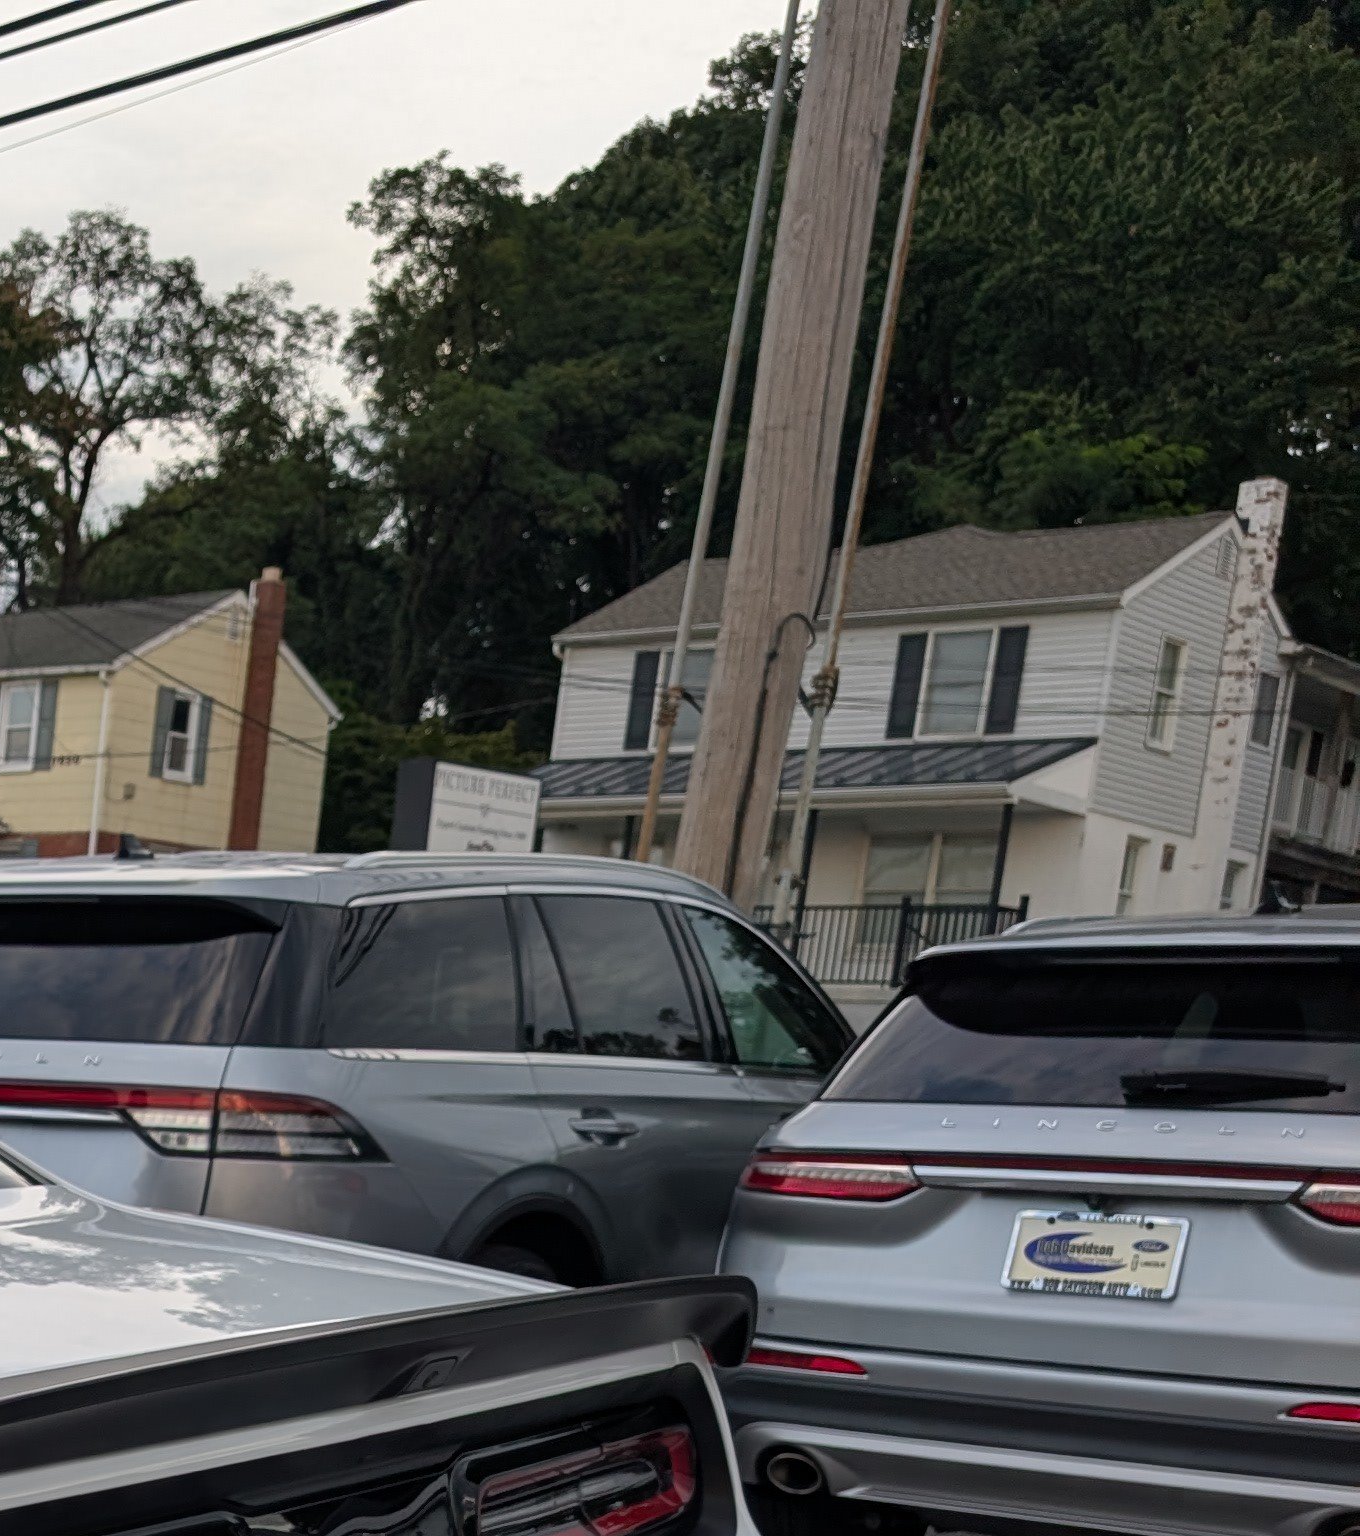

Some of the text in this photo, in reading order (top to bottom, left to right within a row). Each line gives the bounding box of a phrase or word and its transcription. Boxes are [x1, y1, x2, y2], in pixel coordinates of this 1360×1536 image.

[488, 777, 536, 803] PERFECT
[940, 1115, 1305, 1139] LINCOLN
[1061, 1240, 1114, 1257] Davidson
